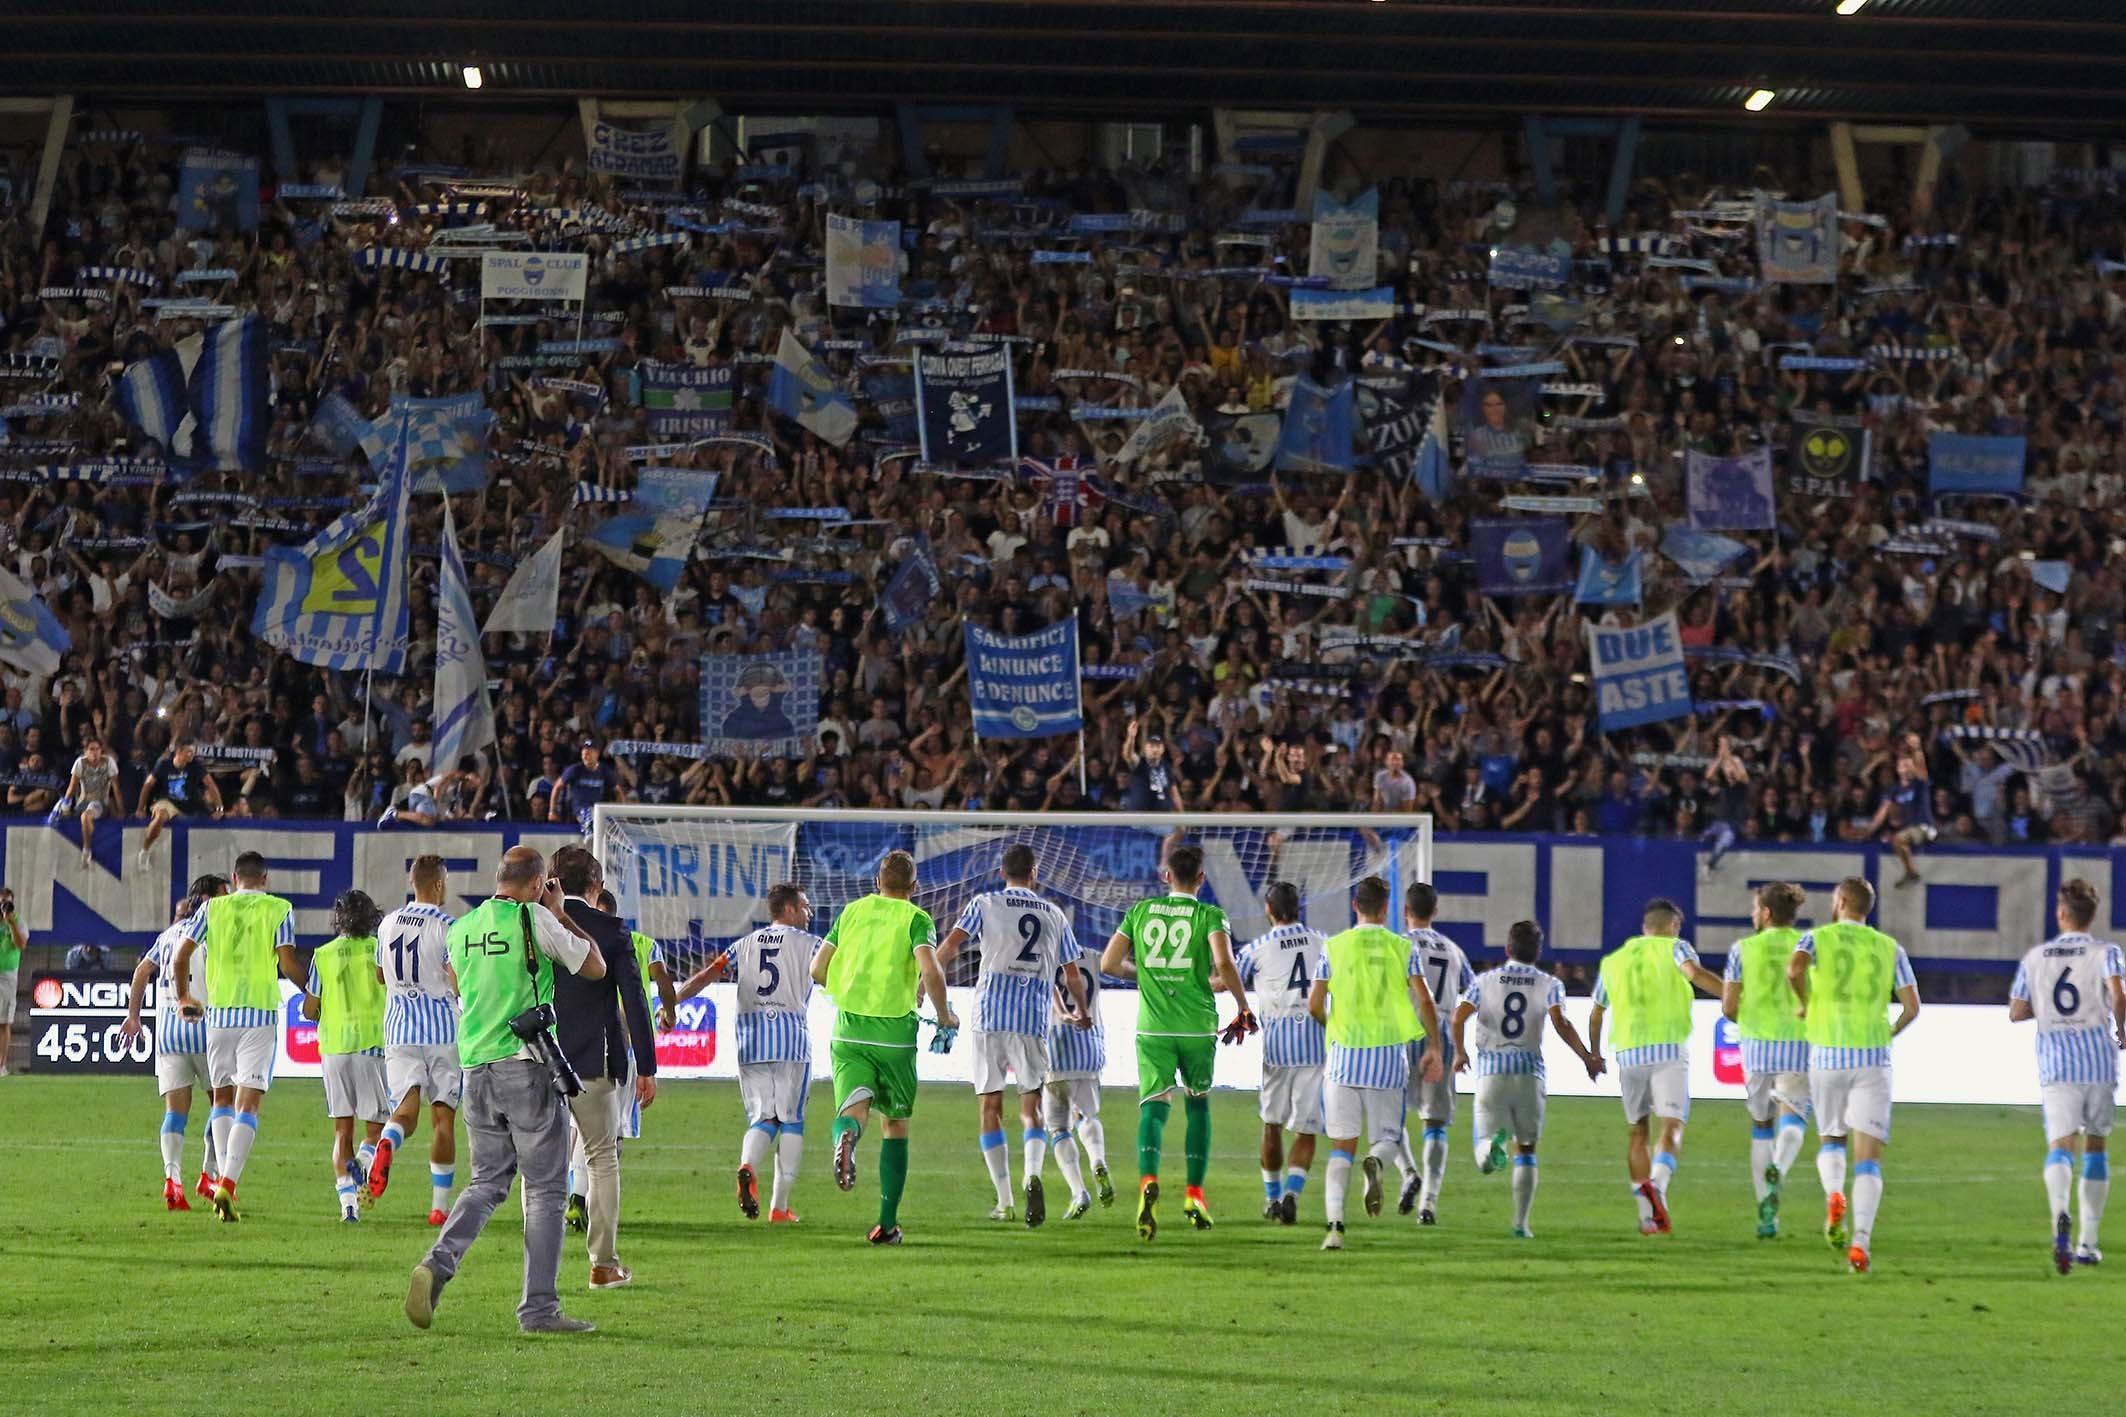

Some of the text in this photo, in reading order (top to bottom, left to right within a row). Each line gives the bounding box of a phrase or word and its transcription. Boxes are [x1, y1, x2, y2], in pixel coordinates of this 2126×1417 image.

[489, 258, 582, 270] SPAL CLUB
[645, 366, 732, 385] VECCHIO
[658, 417, 716, 434] IRISH
[1790, 476, 1852, 497] SPAL
[972, 626, 1067, 650] SACRIFICI
[1598, 621, 1673, 666] DUE
[979, 653, 1064, 676] RINUNCE
[975, 679, 1074, 704] E DENUNCE
[1601, 670, 1691, 715] ASTE
[1006, 898, 1051, 913] GASPARETTO
[464, 931, 510, 958] HS
[757, 934, 784, 944] GIANI
[1015, 913, 1042, 963] 2
[1142, 918, 1193, 969] 22
[1280, 936, 1309, 951] ARINI
[389, 933, 421, 984] 11
[756, 948, 780, 997] 5
[1286, 951, 1312, 999] 4
[1428, 956, 1449, 1006] 7
[61, 983, 154, 1007] NGM
[2053, 965, 2080, 1017] 6
[1500, 991, 1528, 1040] 8
[37, 1022, 154, 1063] 45:00
